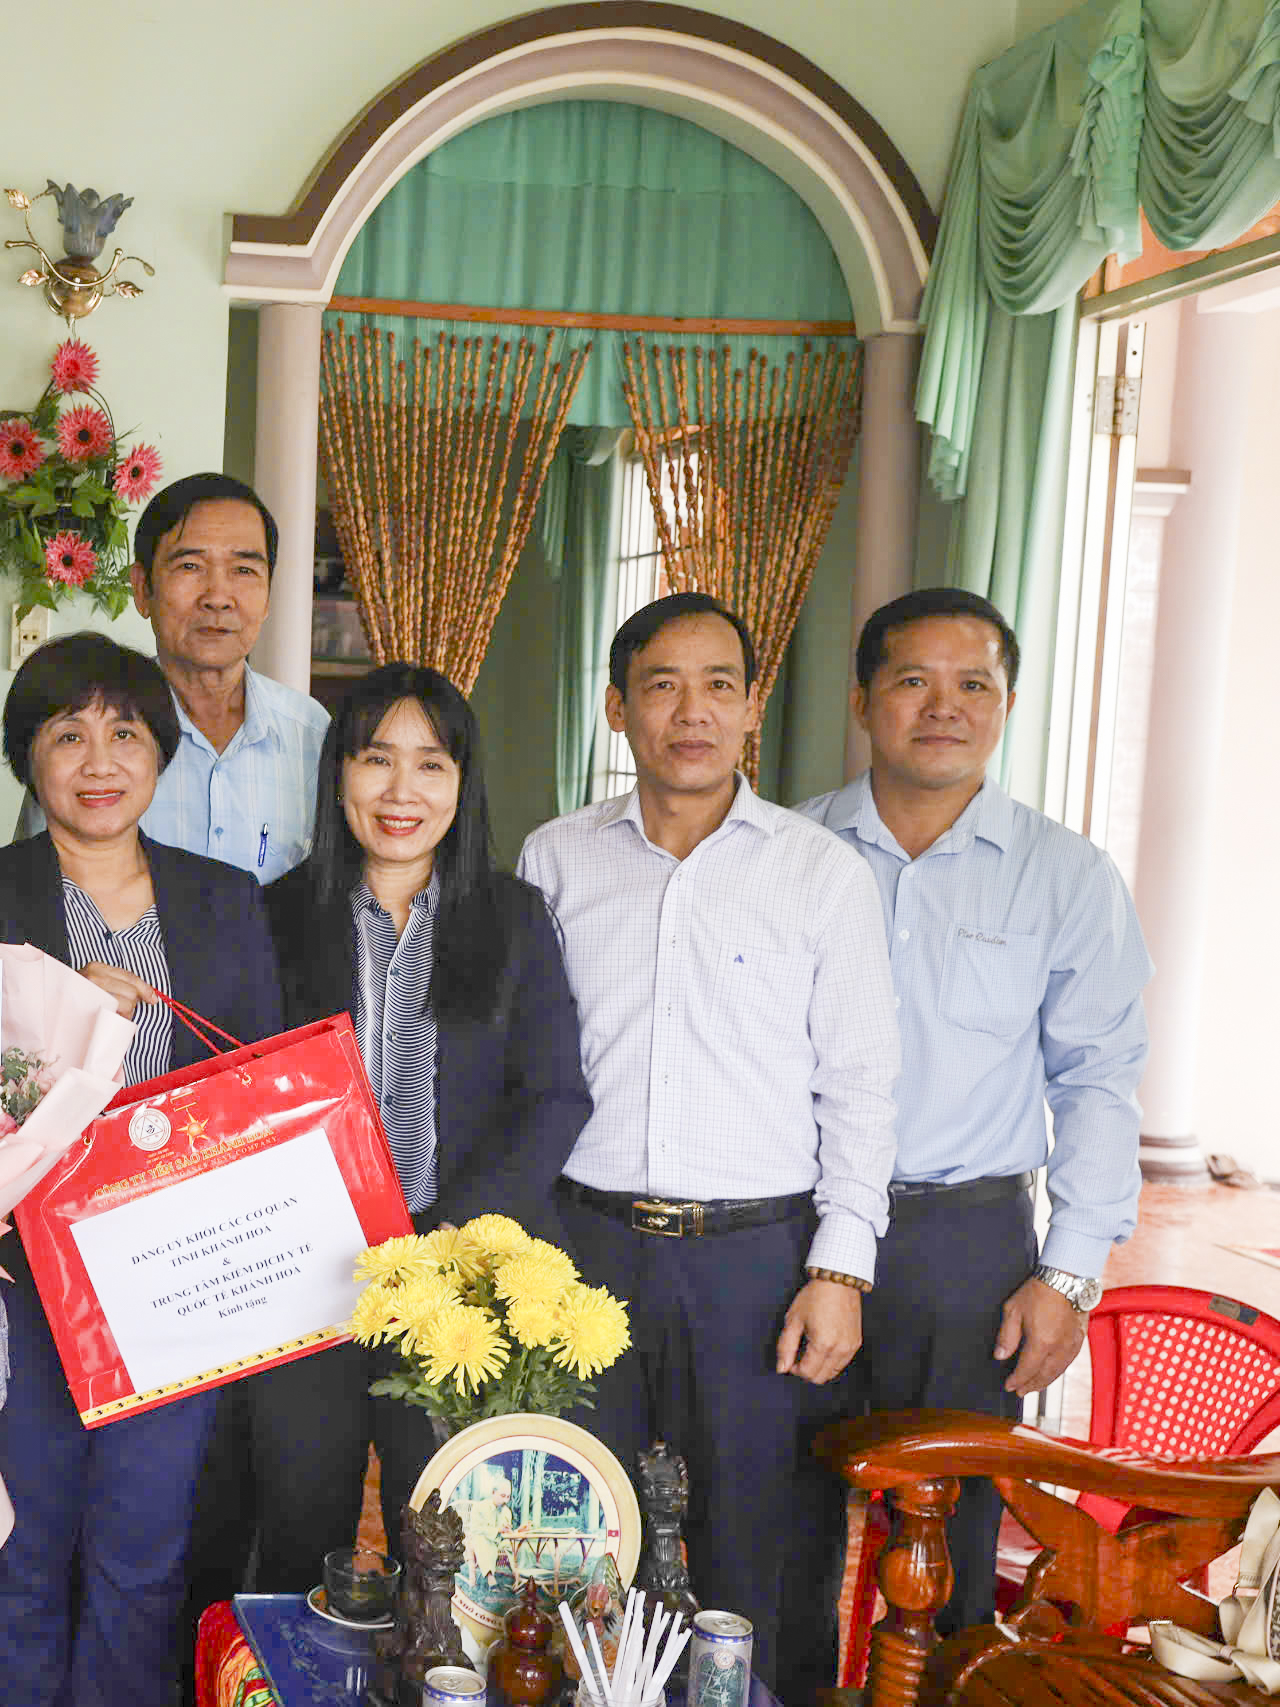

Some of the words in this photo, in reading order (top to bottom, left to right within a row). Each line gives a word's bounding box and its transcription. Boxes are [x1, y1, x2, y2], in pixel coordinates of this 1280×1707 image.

[235, 1135, 278, 1156] COMPANY
[95, 1178, 129, 1198] CÔNG
[129, 1172, 146, 1186] TY
[219, 1217, 244, 1232] CÁC
[245, 1208, 263, 1222] CƠ
[265, 1195, 298, 1216] QUAN
[201, 1234, 244, 1257] KHÁNH
[222, 1257, 232, 1266] &
[151, 1288, 192, 1309] TRUNG
[193, 1276, 220, 1293] TÂM
[255, 1252, 285, 1270] DỊCH
[287, 1249, 295, 1259] Y
[231, 1274, 273, 1297] KHÁNH
[218, 1303, 244, 1319] Kính
[245, 1295, 268, 1310] tặng
